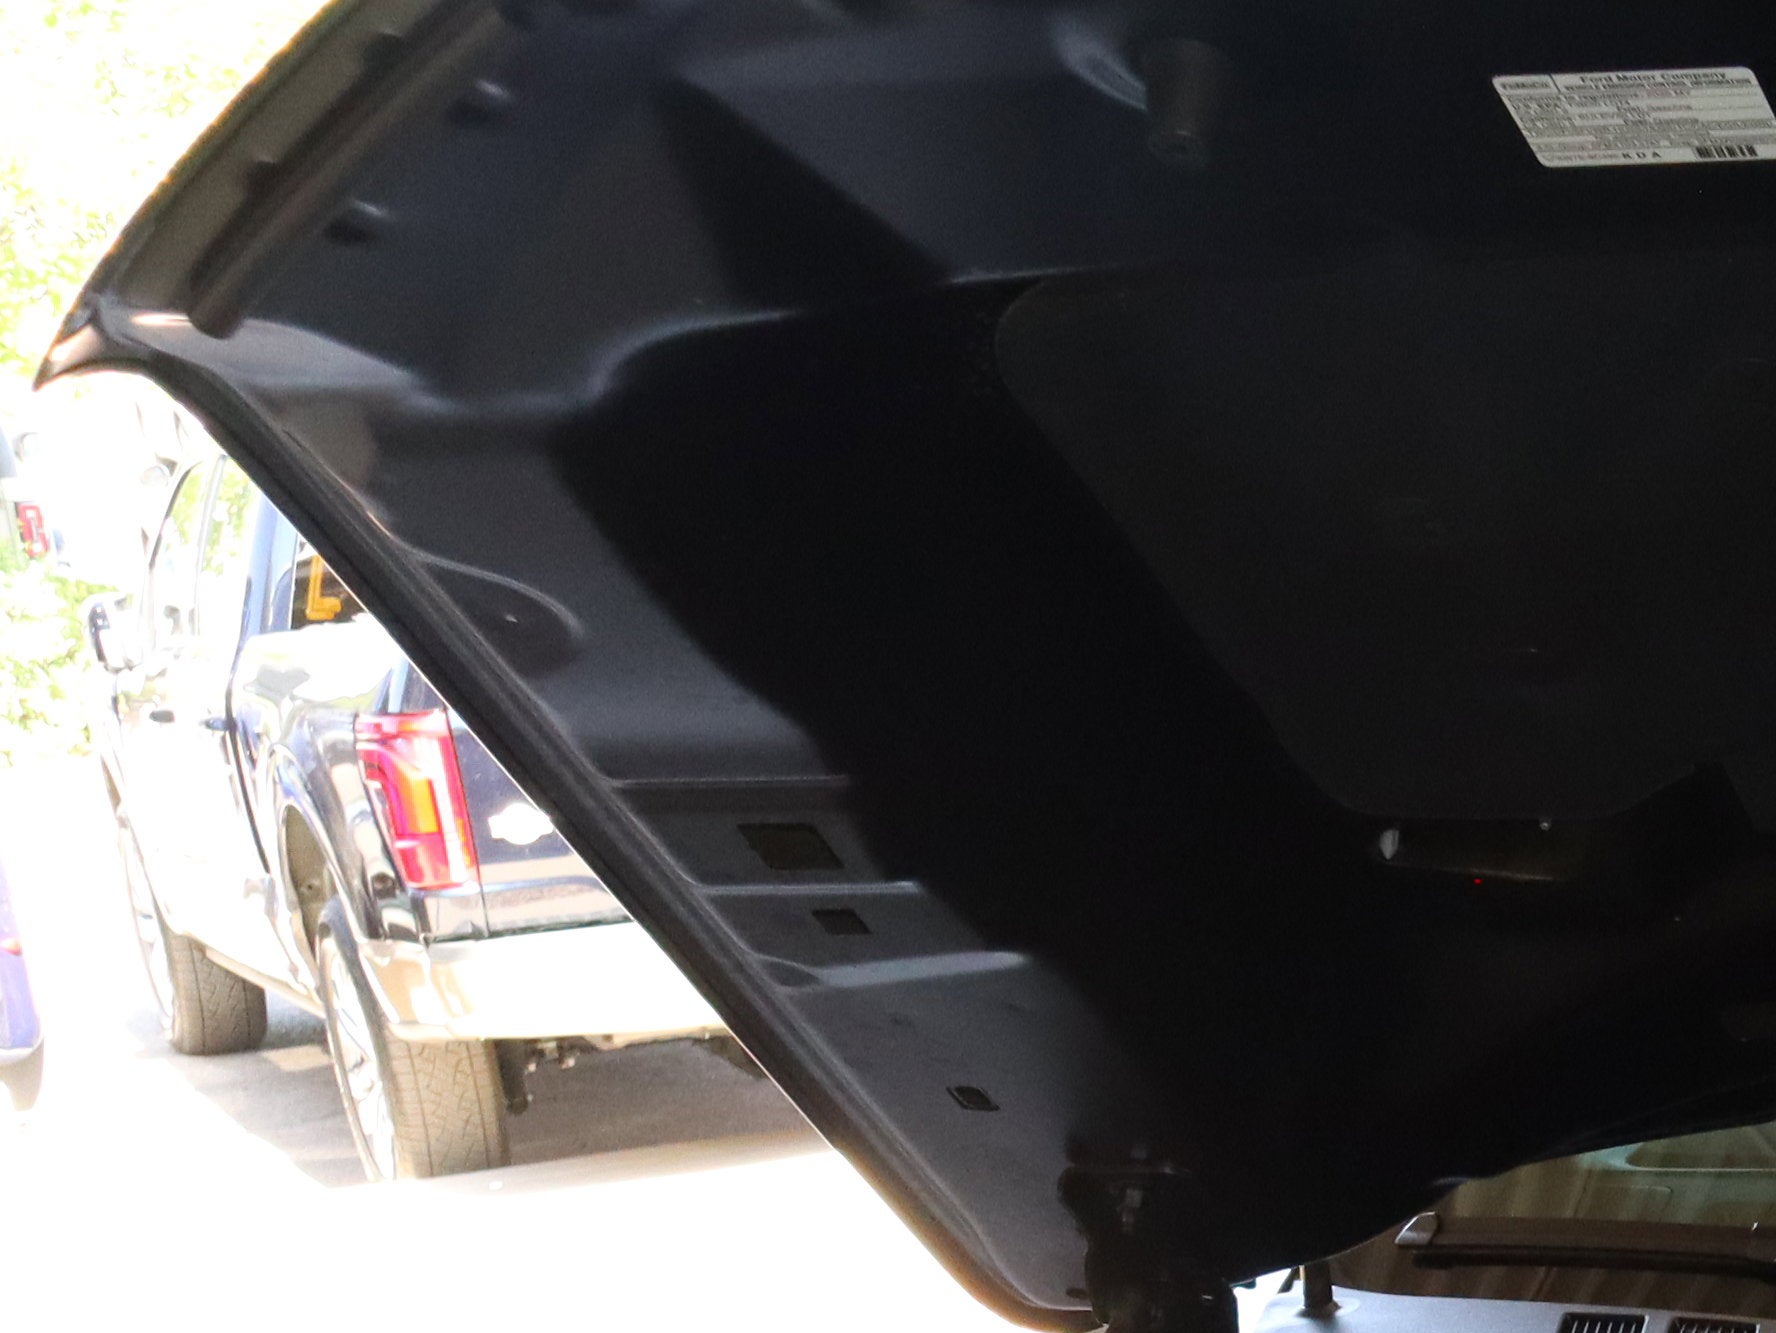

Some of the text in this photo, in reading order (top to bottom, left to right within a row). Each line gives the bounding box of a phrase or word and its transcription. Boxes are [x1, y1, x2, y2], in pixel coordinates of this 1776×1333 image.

[1579, 72, 1726, 83] Ford Motor Company
